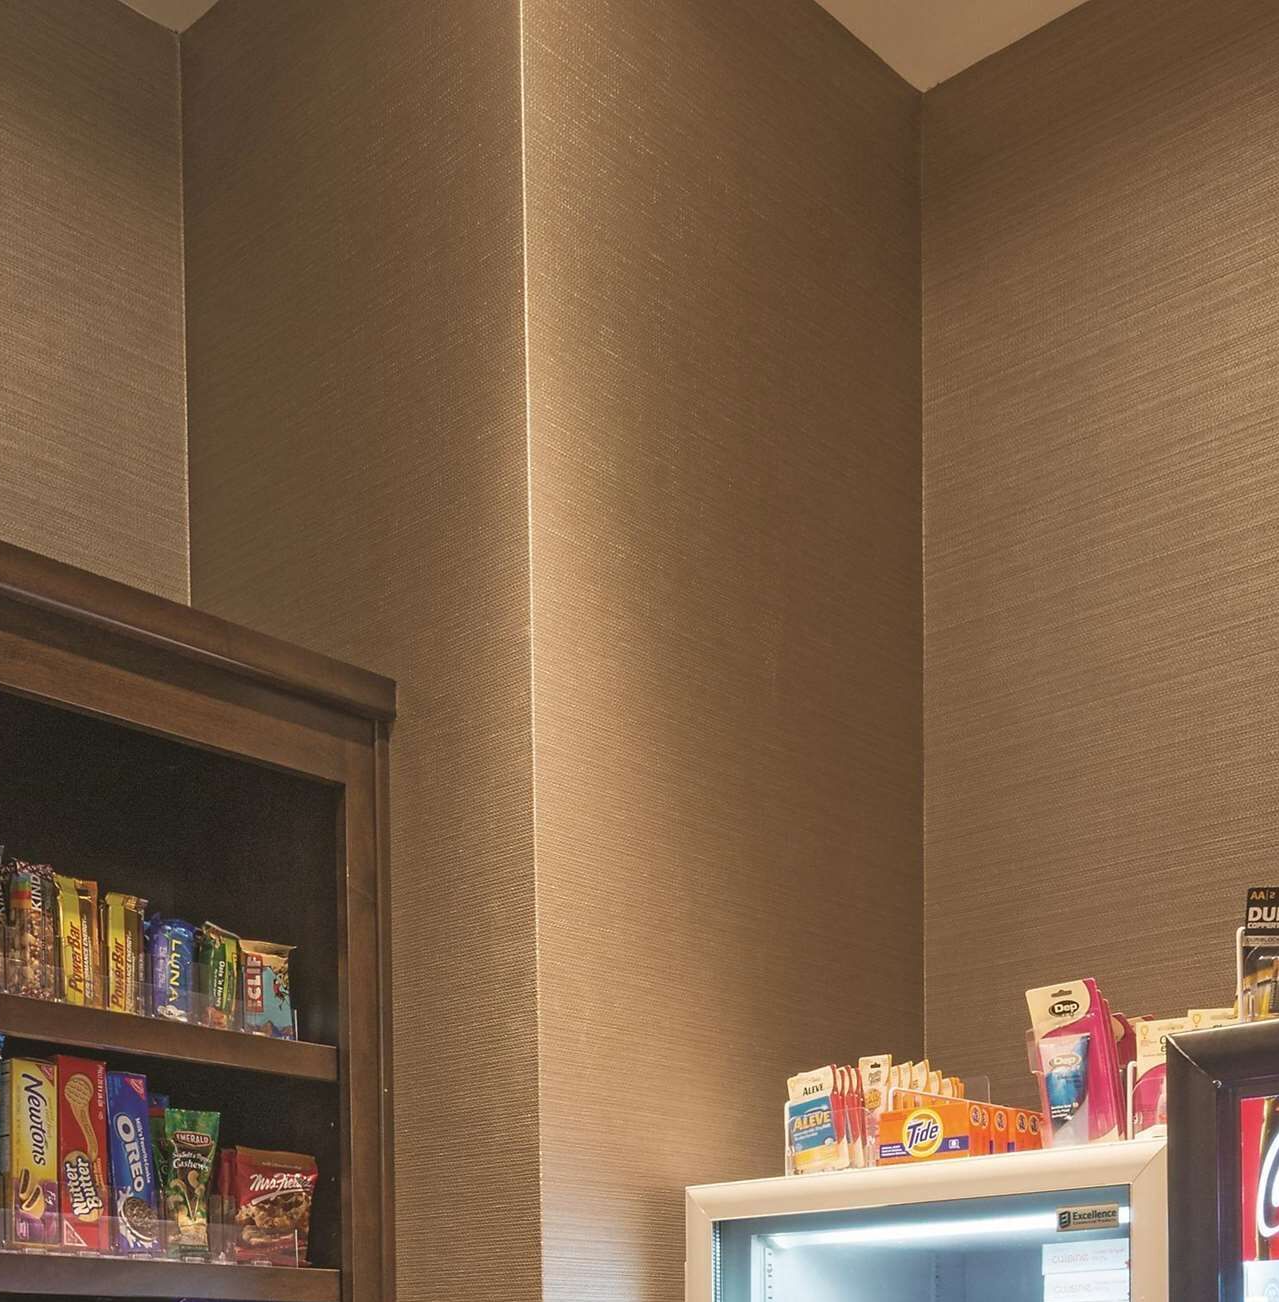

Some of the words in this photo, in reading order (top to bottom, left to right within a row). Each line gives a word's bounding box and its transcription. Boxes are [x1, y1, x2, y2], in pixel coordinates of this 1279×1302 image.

[31, 872, 42, 912] KIND
[1250, 891, 1265, 900] AA
[66, 921, 84, 995] PowerBar
[168, 939, 183, 1002] LUNA
[111, 937, 125, 1009] PowerBar
[247, 956, 262, 999] CLIF
[1054, 1002, 1078, 1016] Dep
[1053, 1055, 1078, 1067] Dep
[803, 1084, 824, 1096] ALEVE
[22, 1073, 48, 1166] Newtons
[793, 1111, 831, 1132] ALEVE
[176, 1132, 210, 1144] EMERALD
[907, 1120, 939, 1148] Tide
[117, 1111, 144, 1192] OREO
[172, 1159, 209, 1172] Cashews
[64, 1161, 90, 1216] Nutter
[77, 1157, 103, 1209] Butter
[45, 1190, 57, 1206] Fig
[1072, 1209, 1117, 1220] Excellence
